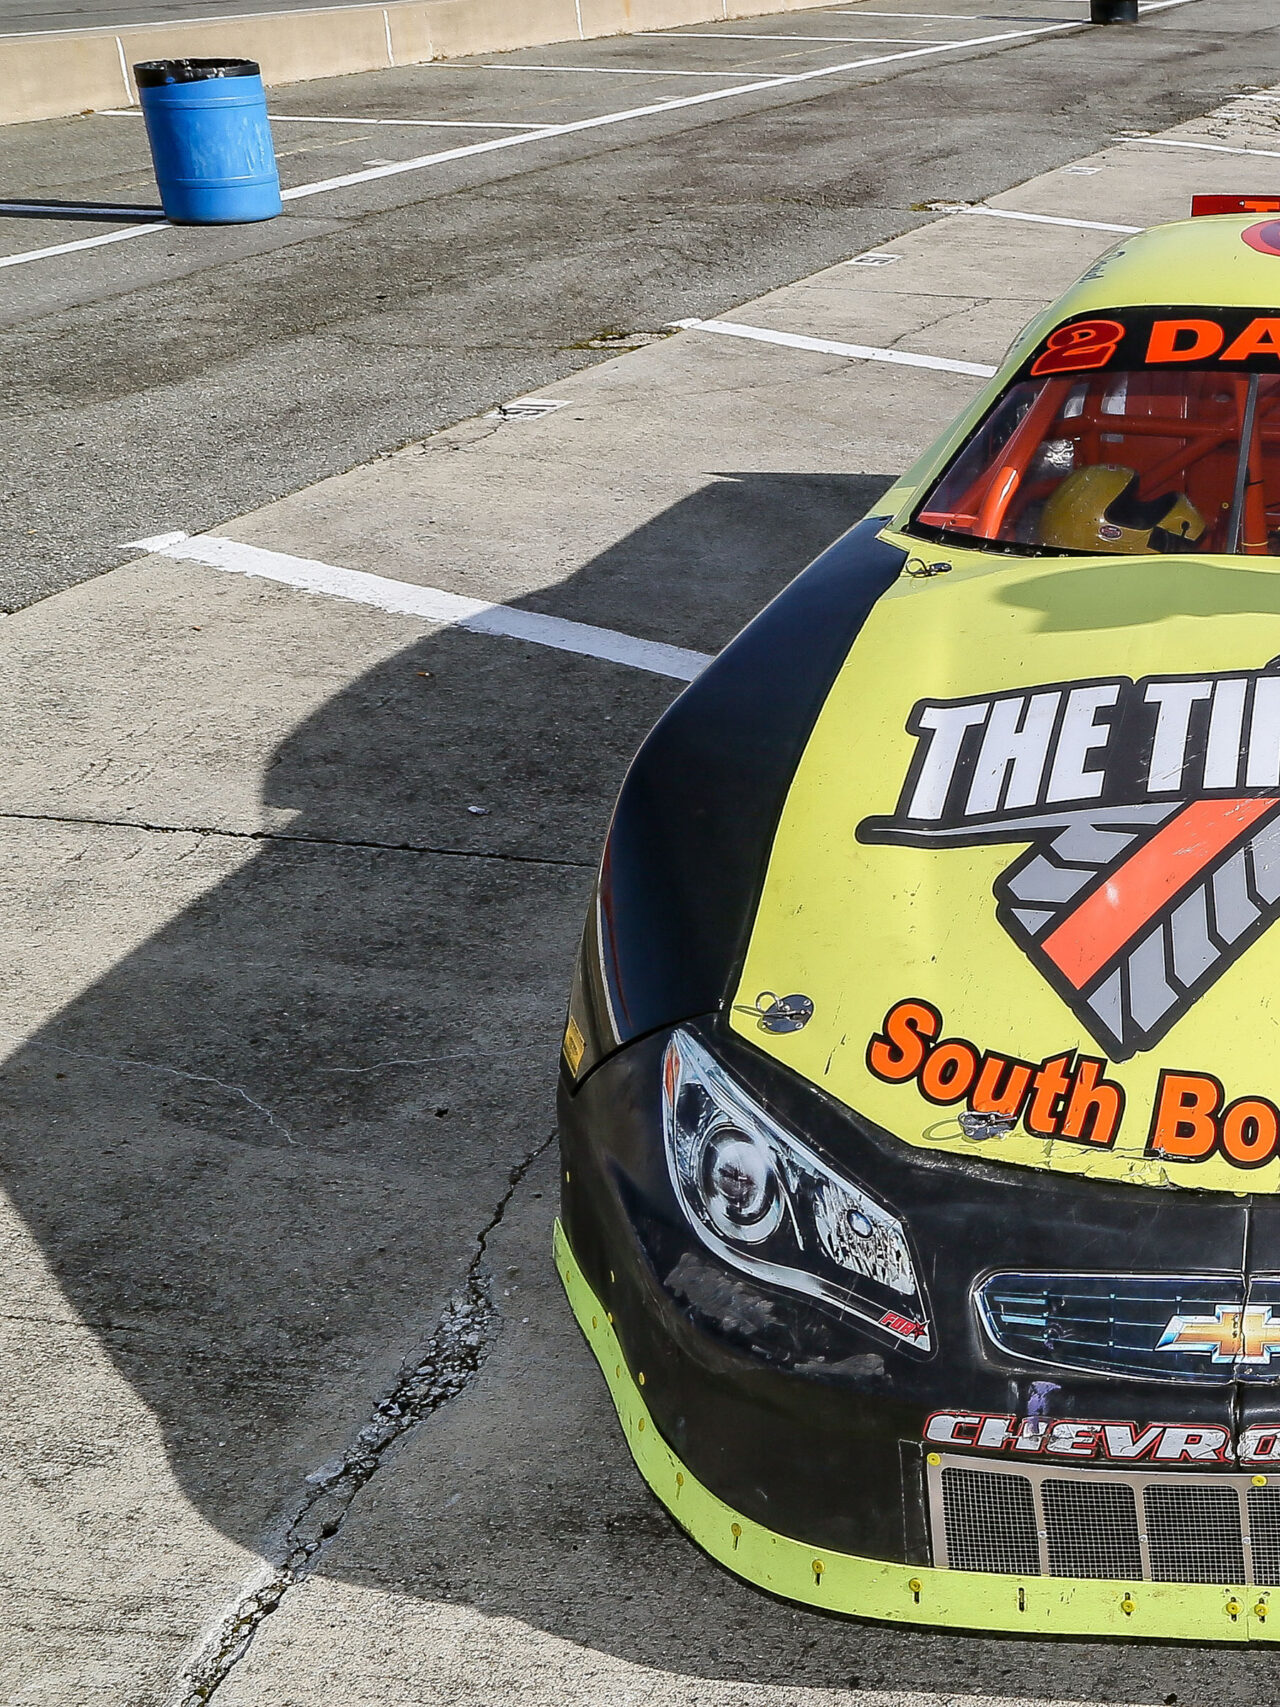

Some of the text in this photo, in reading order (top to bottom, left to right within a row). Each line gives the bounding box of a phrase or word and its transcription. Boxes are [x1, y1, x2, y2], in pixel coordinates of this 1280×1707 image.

[1030, 319, 1126, 377] 2
[906, 685, 1122, 821] THE
[867, 997, 1127, 1150] South
